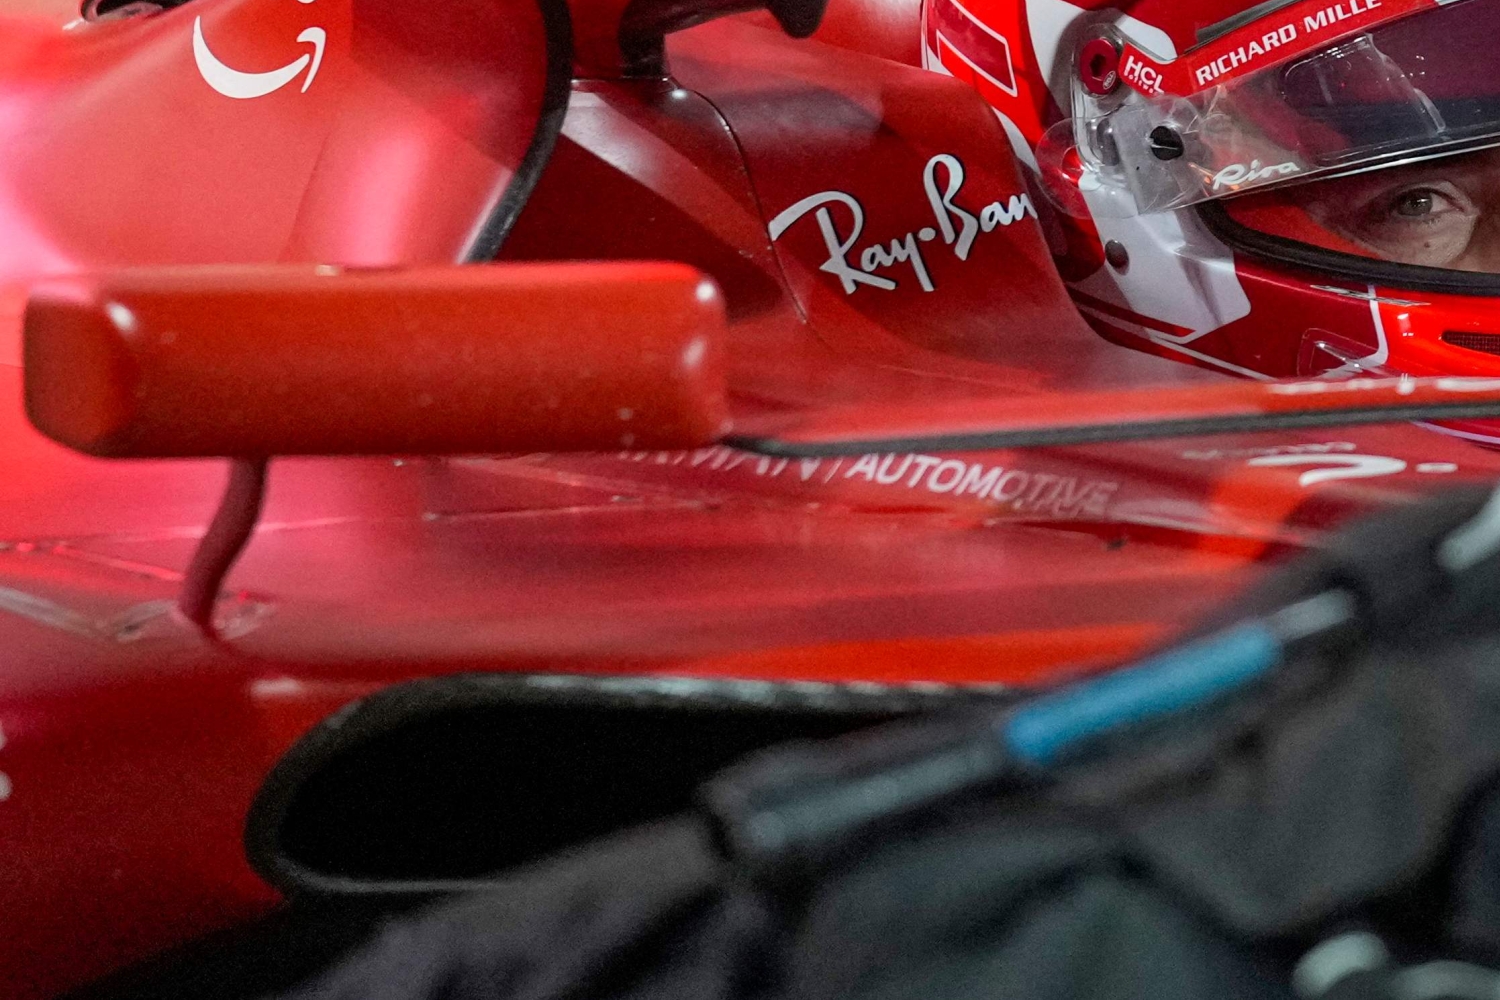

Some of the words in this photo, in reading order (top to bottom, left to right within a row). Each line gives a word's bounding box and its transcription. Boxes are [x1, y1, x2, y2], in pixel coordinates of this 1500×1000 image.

[1123, 55, 1165, 95] HCL
[1195, 22, 1298, 86] RICHARD
[845, 453, 1119, 516] AUTOMOTIVE
